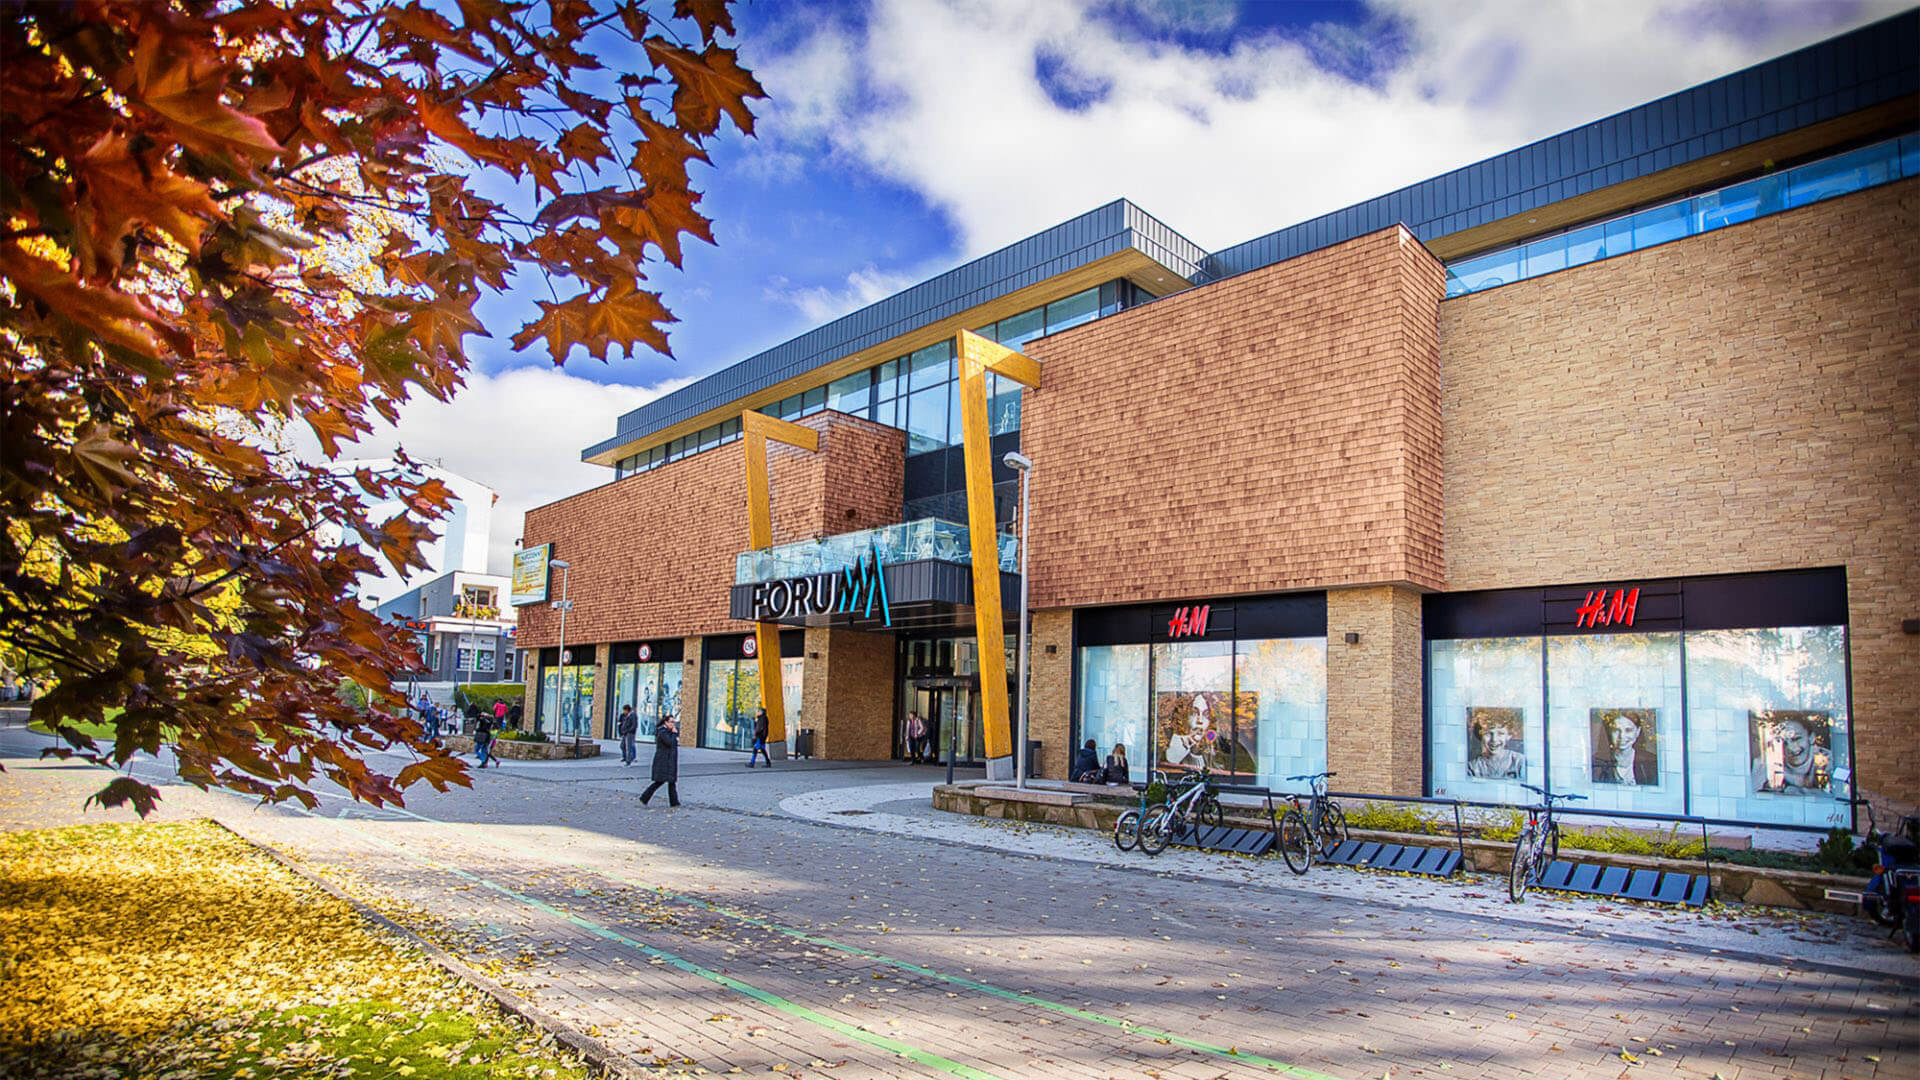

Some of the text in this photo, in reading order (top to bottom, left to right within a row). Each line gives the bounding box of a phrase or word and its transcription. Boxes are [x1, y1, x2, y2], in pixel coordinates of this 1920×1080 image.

[752, 537, 891, 628] FORUM
[1168, 605, 1210, 638] H&M
[1576, 588, 1640, 628] H&M
